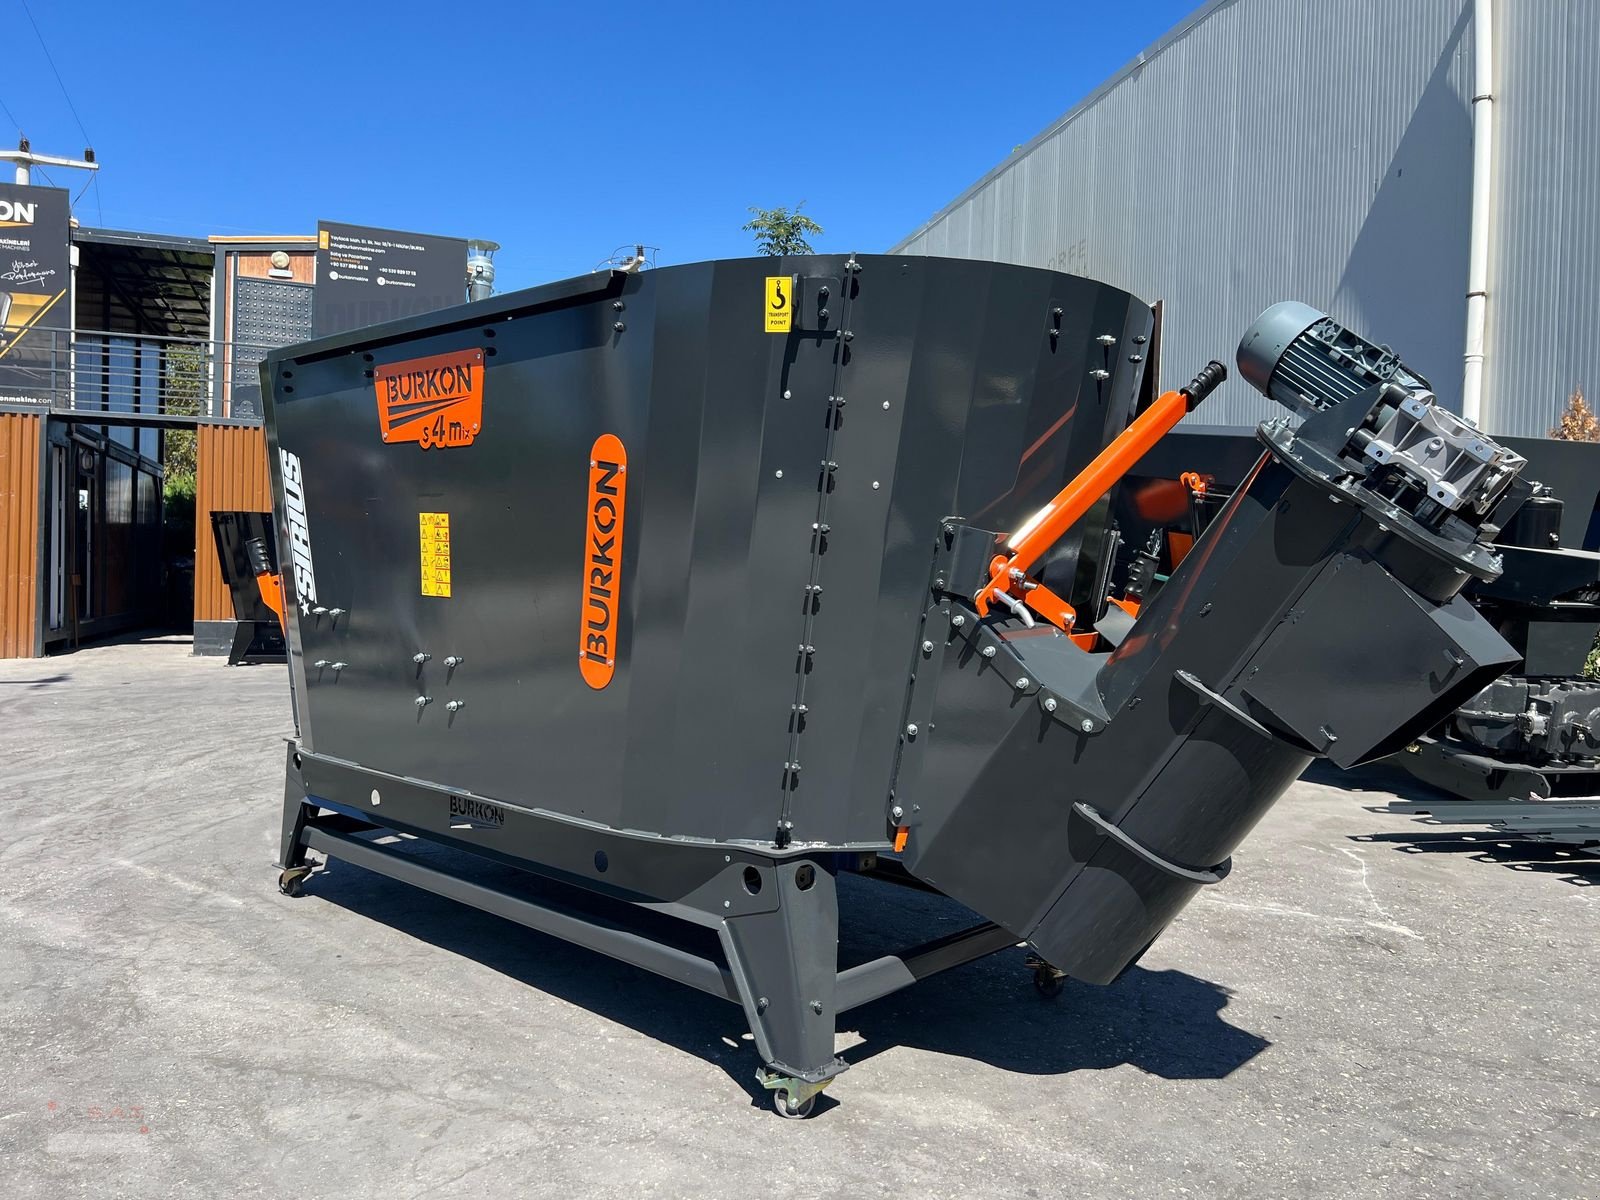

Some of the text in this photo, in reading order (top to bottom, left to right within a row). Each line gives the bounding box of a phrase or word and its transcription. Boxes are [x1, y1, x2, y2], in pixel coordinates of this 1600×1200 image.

[385, 362, 473, 403] BURKON
[281, 449, 315, 602] SIRIUS
[585, 459, 620, 665] BURKON
[449, 795, 505, 826] BURKON
